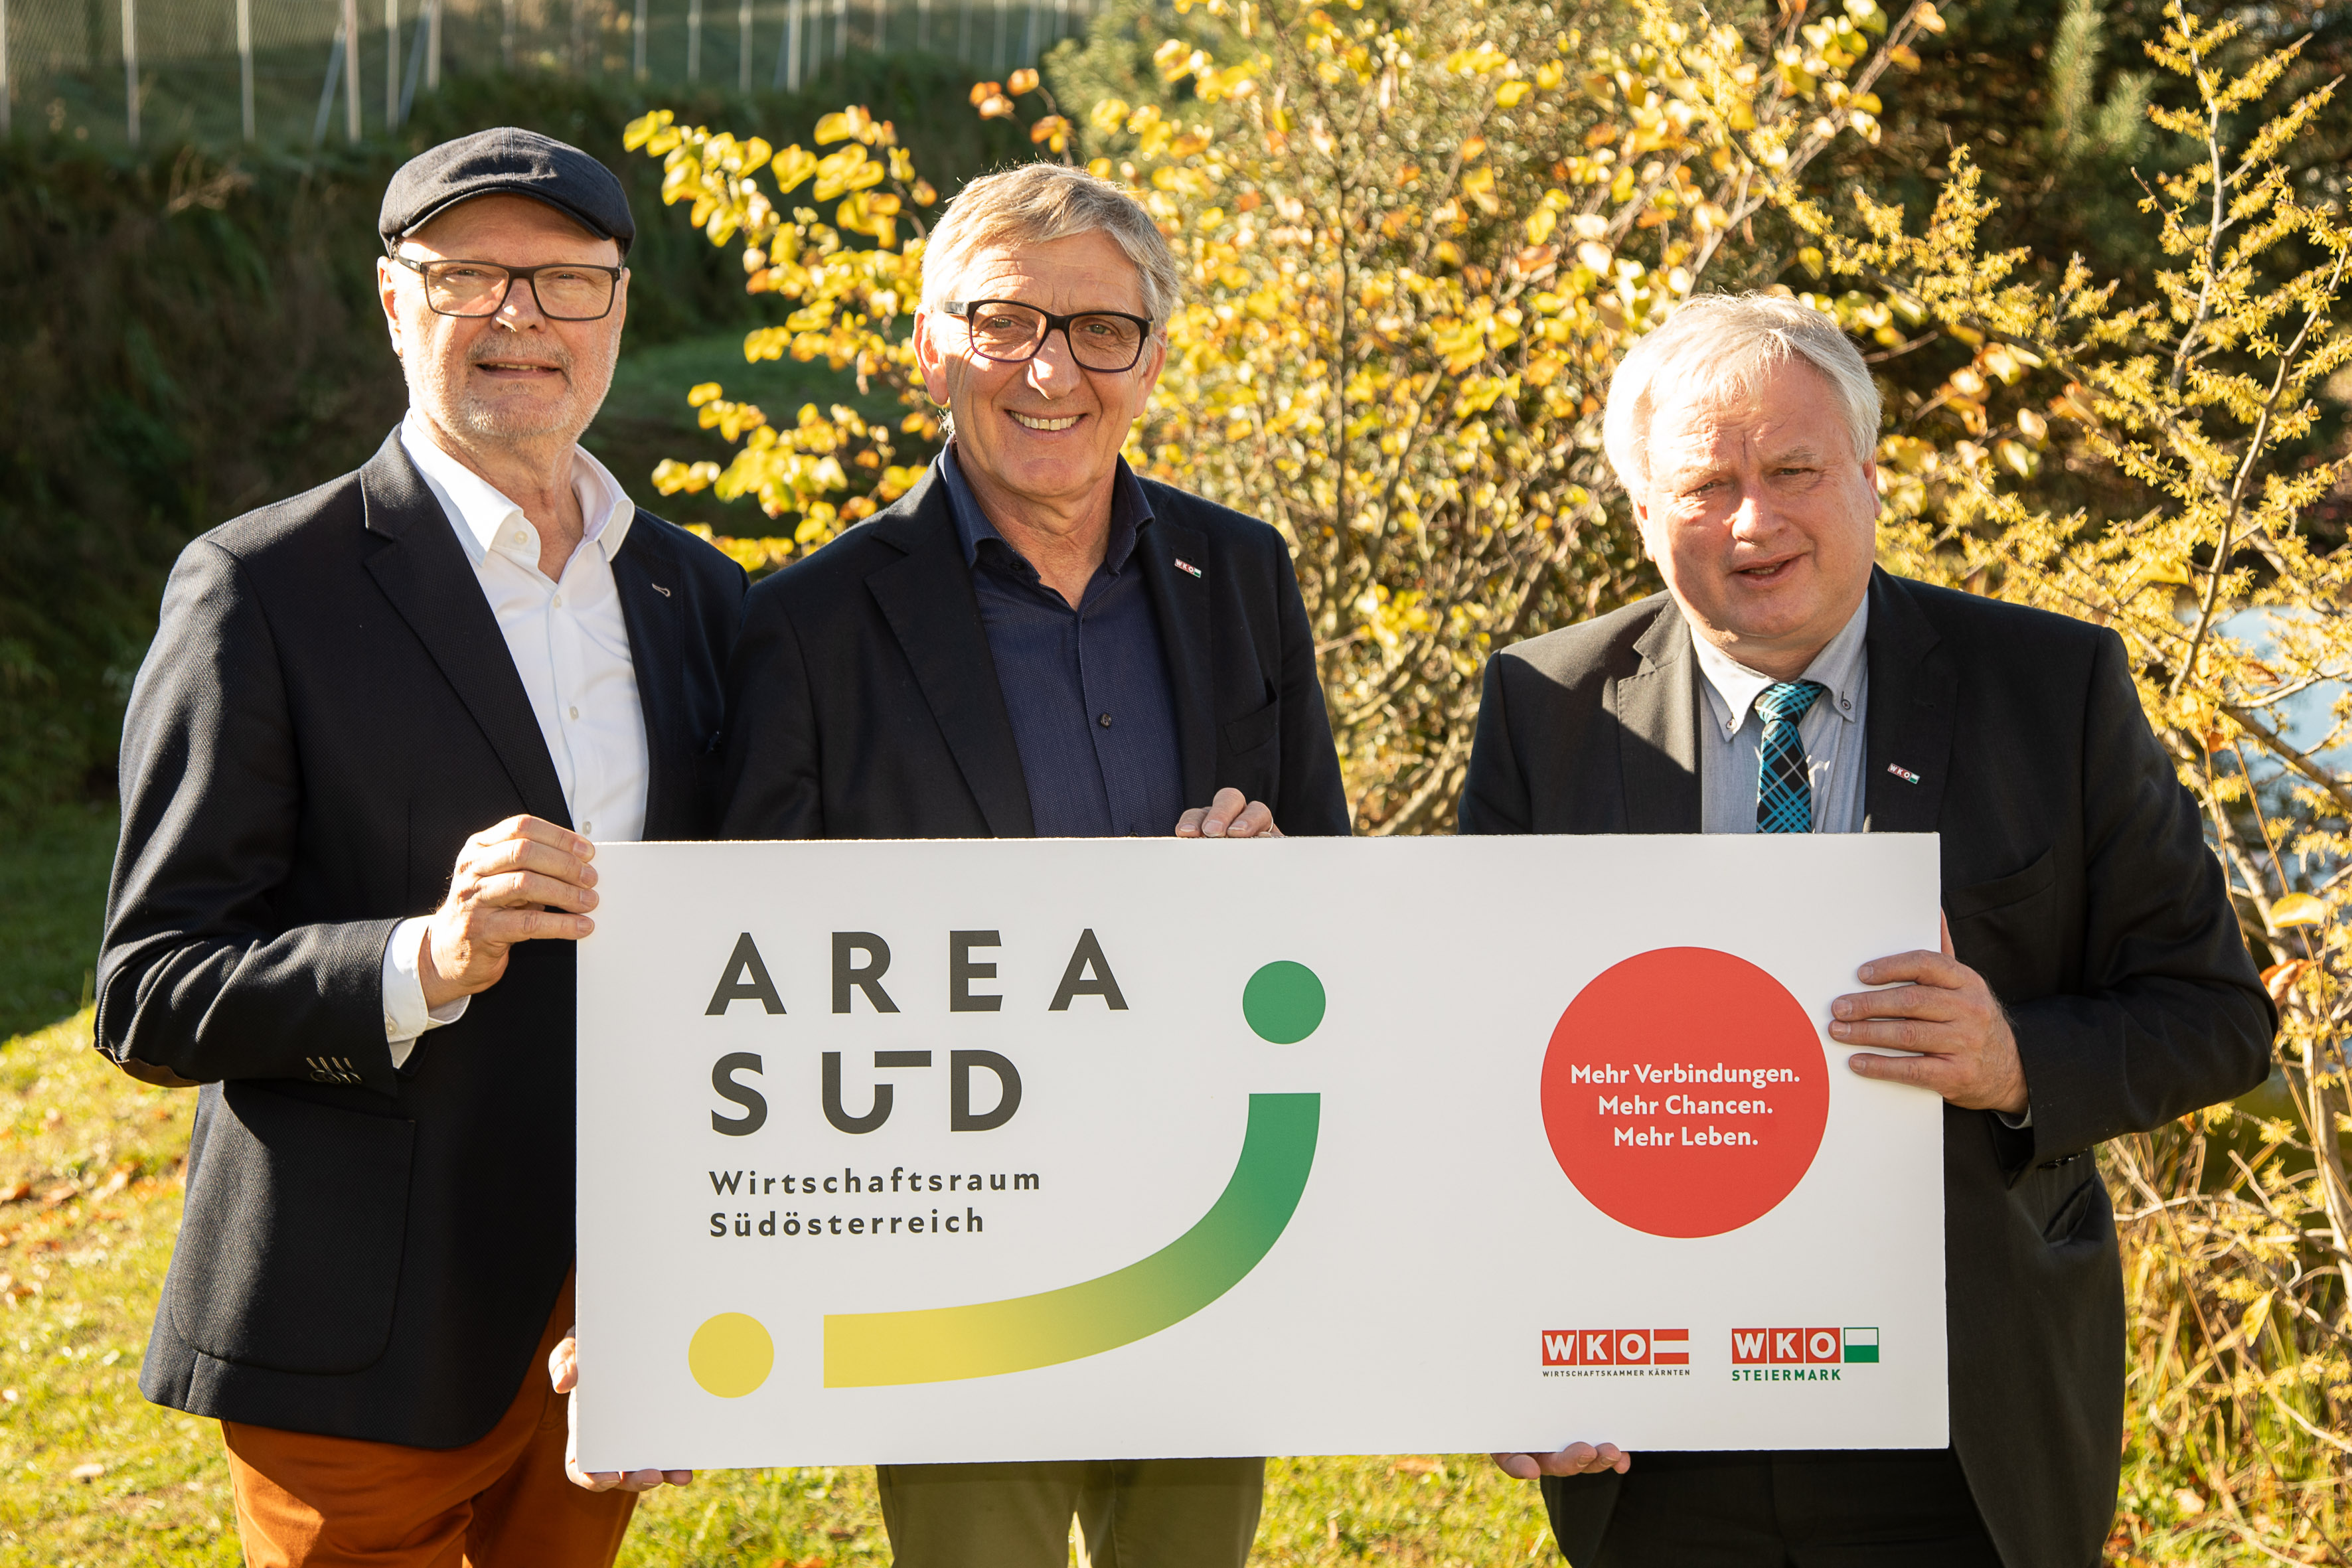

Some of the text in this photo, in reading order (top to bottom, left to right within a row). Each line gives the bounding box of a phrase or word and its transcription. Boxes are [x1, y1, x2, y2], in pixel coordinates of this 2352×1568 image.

[1176, 559, 1194, 573] WKO
[1890, 765, 1911, 779] WKO
[704, 928, 1130, 1016] AREA
[1571, 1063, 1800, 1089] Mehr Verbindungen.
[1599, 1095, 1773, 1115] Mehr Chancen.
[1614, 1126, 1759, 1146] Mehr Leben.
[709, 1167, 1041, 1196] Wirtschaftsraum
[710, 1207, 984, 1237] Südösterreich
[1543, 1333, 1647, 1361] WKO
[1733, 1331, 1837, 1360] WKO
[1648, 1368, 1691, 1377] KÄRNTEN
[1731, 1368, 1842, 1381] STEIERMARK
